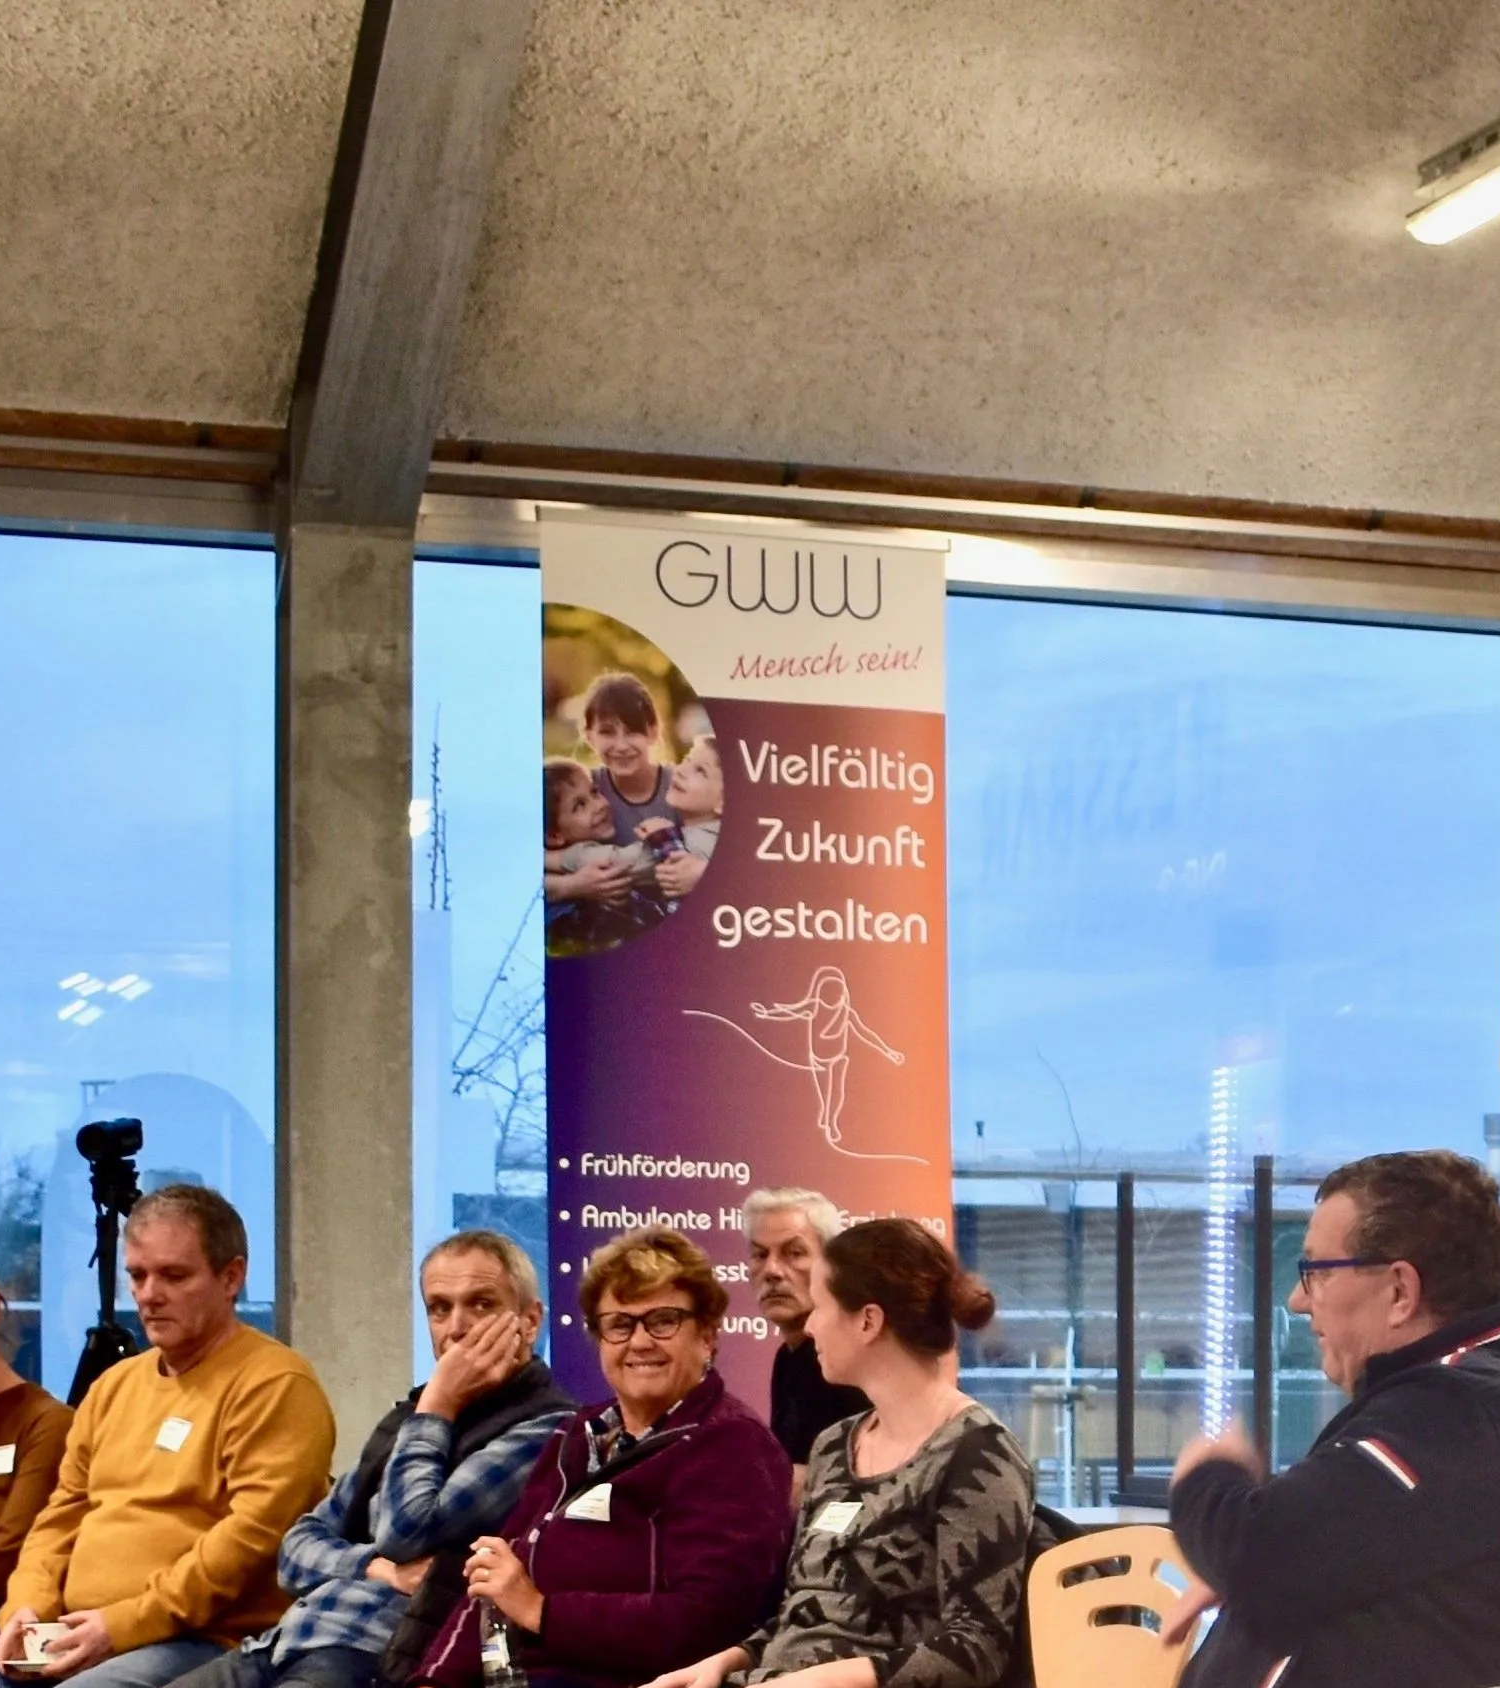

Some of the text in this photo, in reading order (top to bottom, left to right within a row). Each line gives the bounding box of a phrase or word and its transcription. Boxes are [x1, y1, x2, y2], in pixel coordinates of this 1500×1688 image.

[656, 540, 881, 620] GWW
[730, 642, 923, 679] Mensch sein!
[738, 738, 934, 805] Vielfältig
[756, 817, 926, 868] Zukunft
[712, 898, 928, 948] gestalten
[581, 1153, 751, 1185] Frühförderung
[581, 1204, 712, 1231] Ambulante
